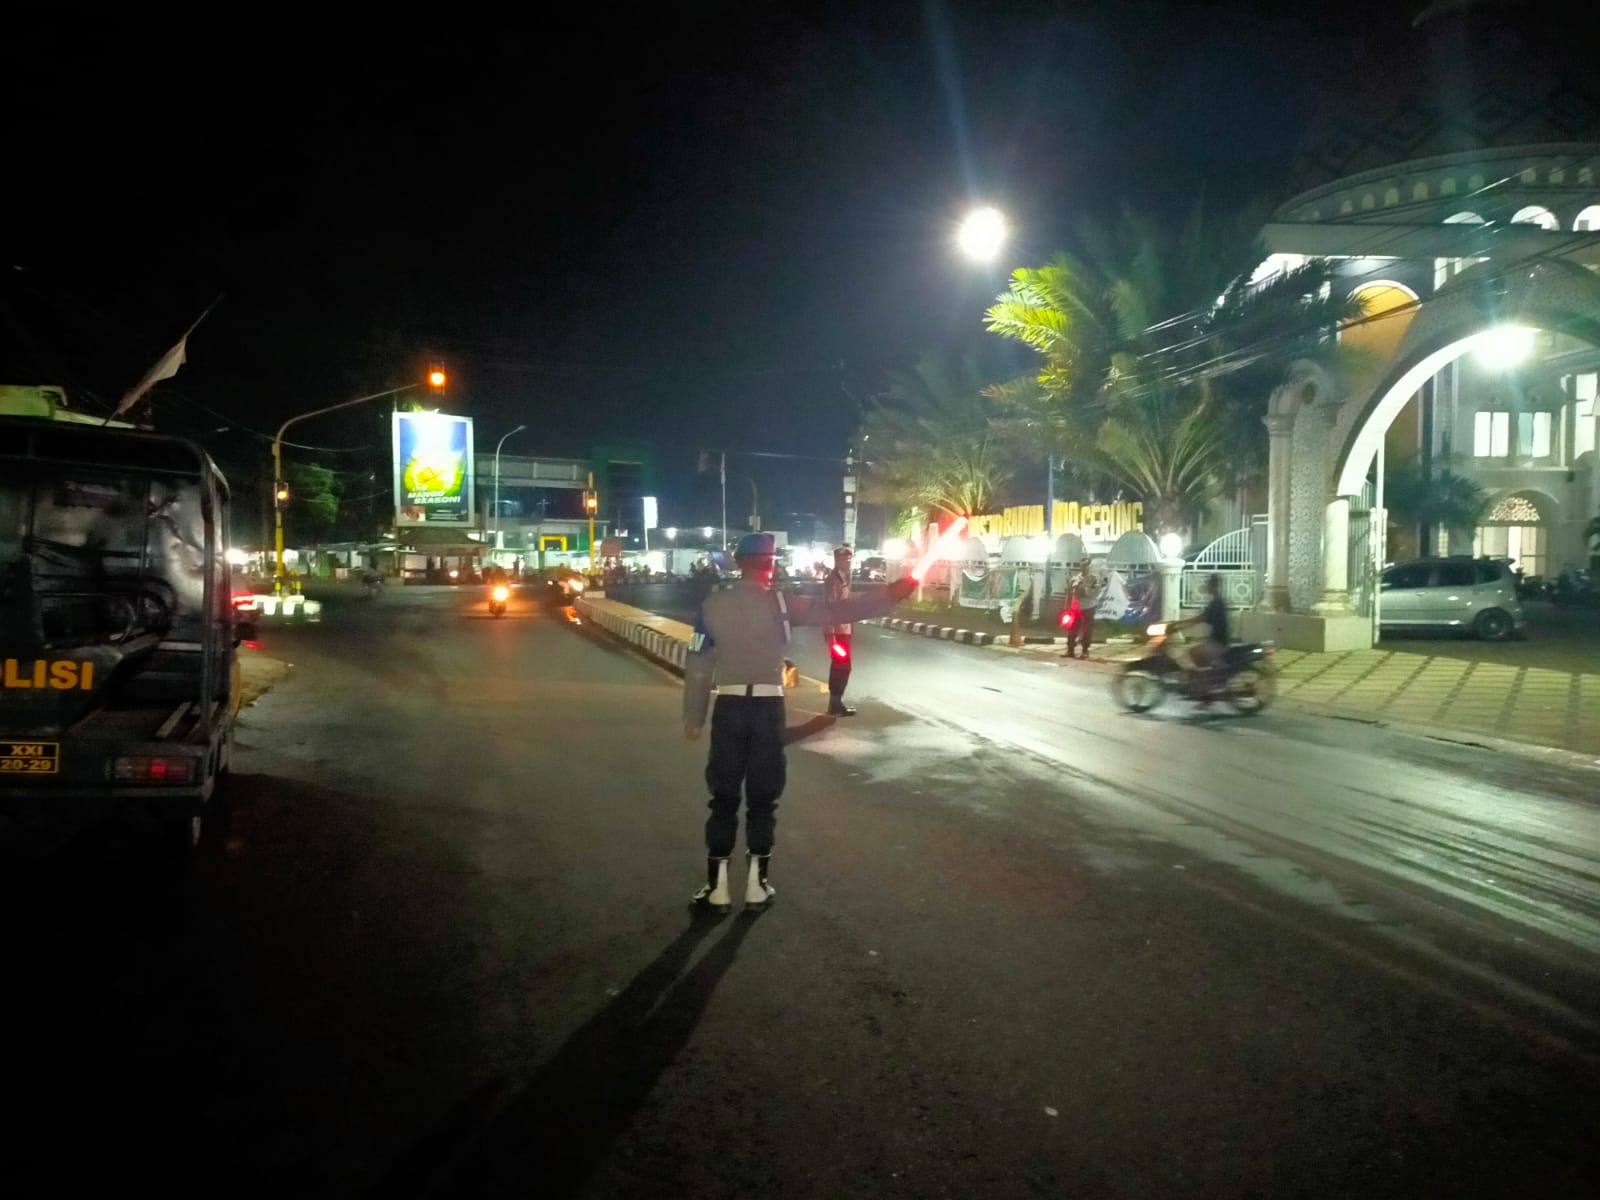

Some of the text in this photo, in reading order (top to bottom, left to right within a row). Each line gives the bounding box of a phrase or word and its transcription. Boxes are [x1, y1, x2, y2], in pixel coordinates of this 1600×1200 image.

[1080, 501, 1144, 542] GERUNG
[0, 658, 94, 690] LISI
[11, 745, 44, 756] XXI
